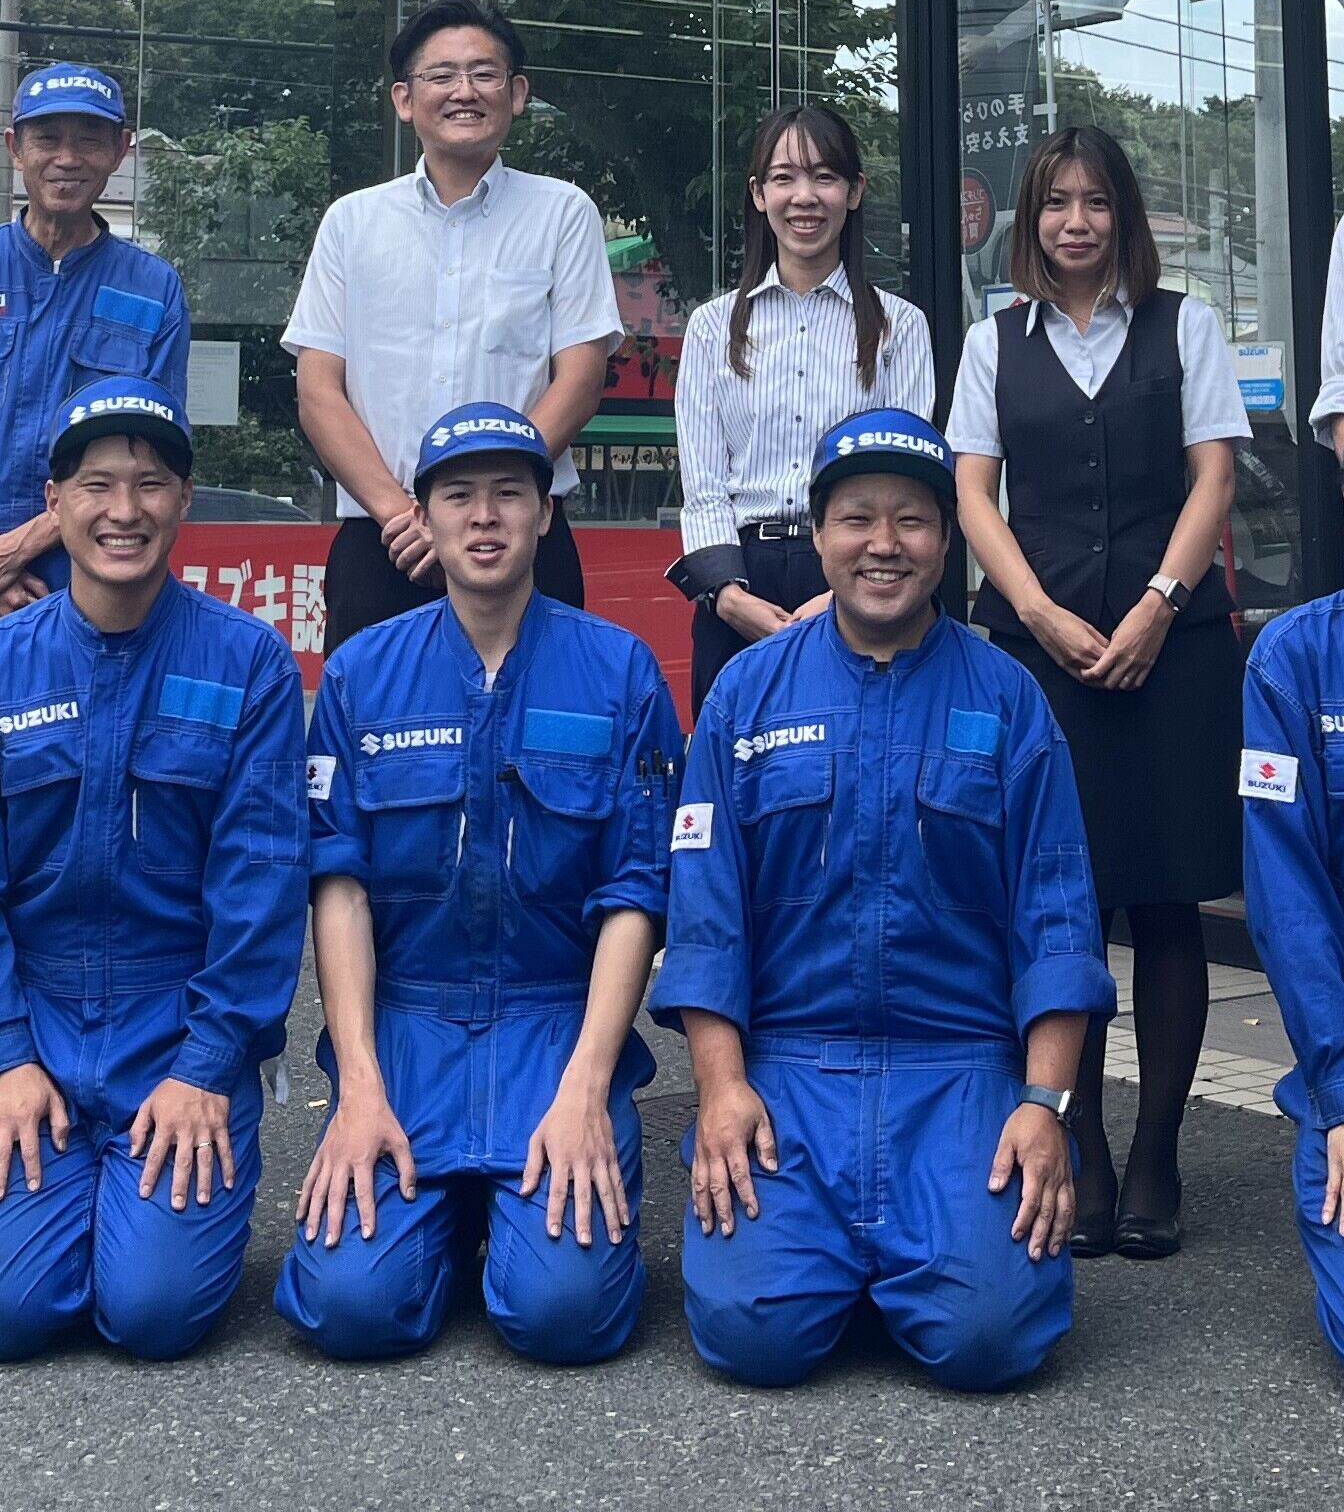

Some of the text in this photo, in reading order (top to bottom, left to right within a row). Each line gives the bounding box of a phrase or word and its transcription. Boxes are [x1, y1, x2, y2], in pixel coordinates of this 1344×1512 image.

[46, 76, 112, 99] SUZUKI
[89, 396, 174, 422] SUZUKI
[452, 418, 536, 440] SUZUKI
[858, 431, 944, 461] SUZUKI
[382, 728, 463, 751] SUZUKI
[752, 724, 825, 754] SUZUKI
[1247, 779, 1286, 793] SUZUKI
